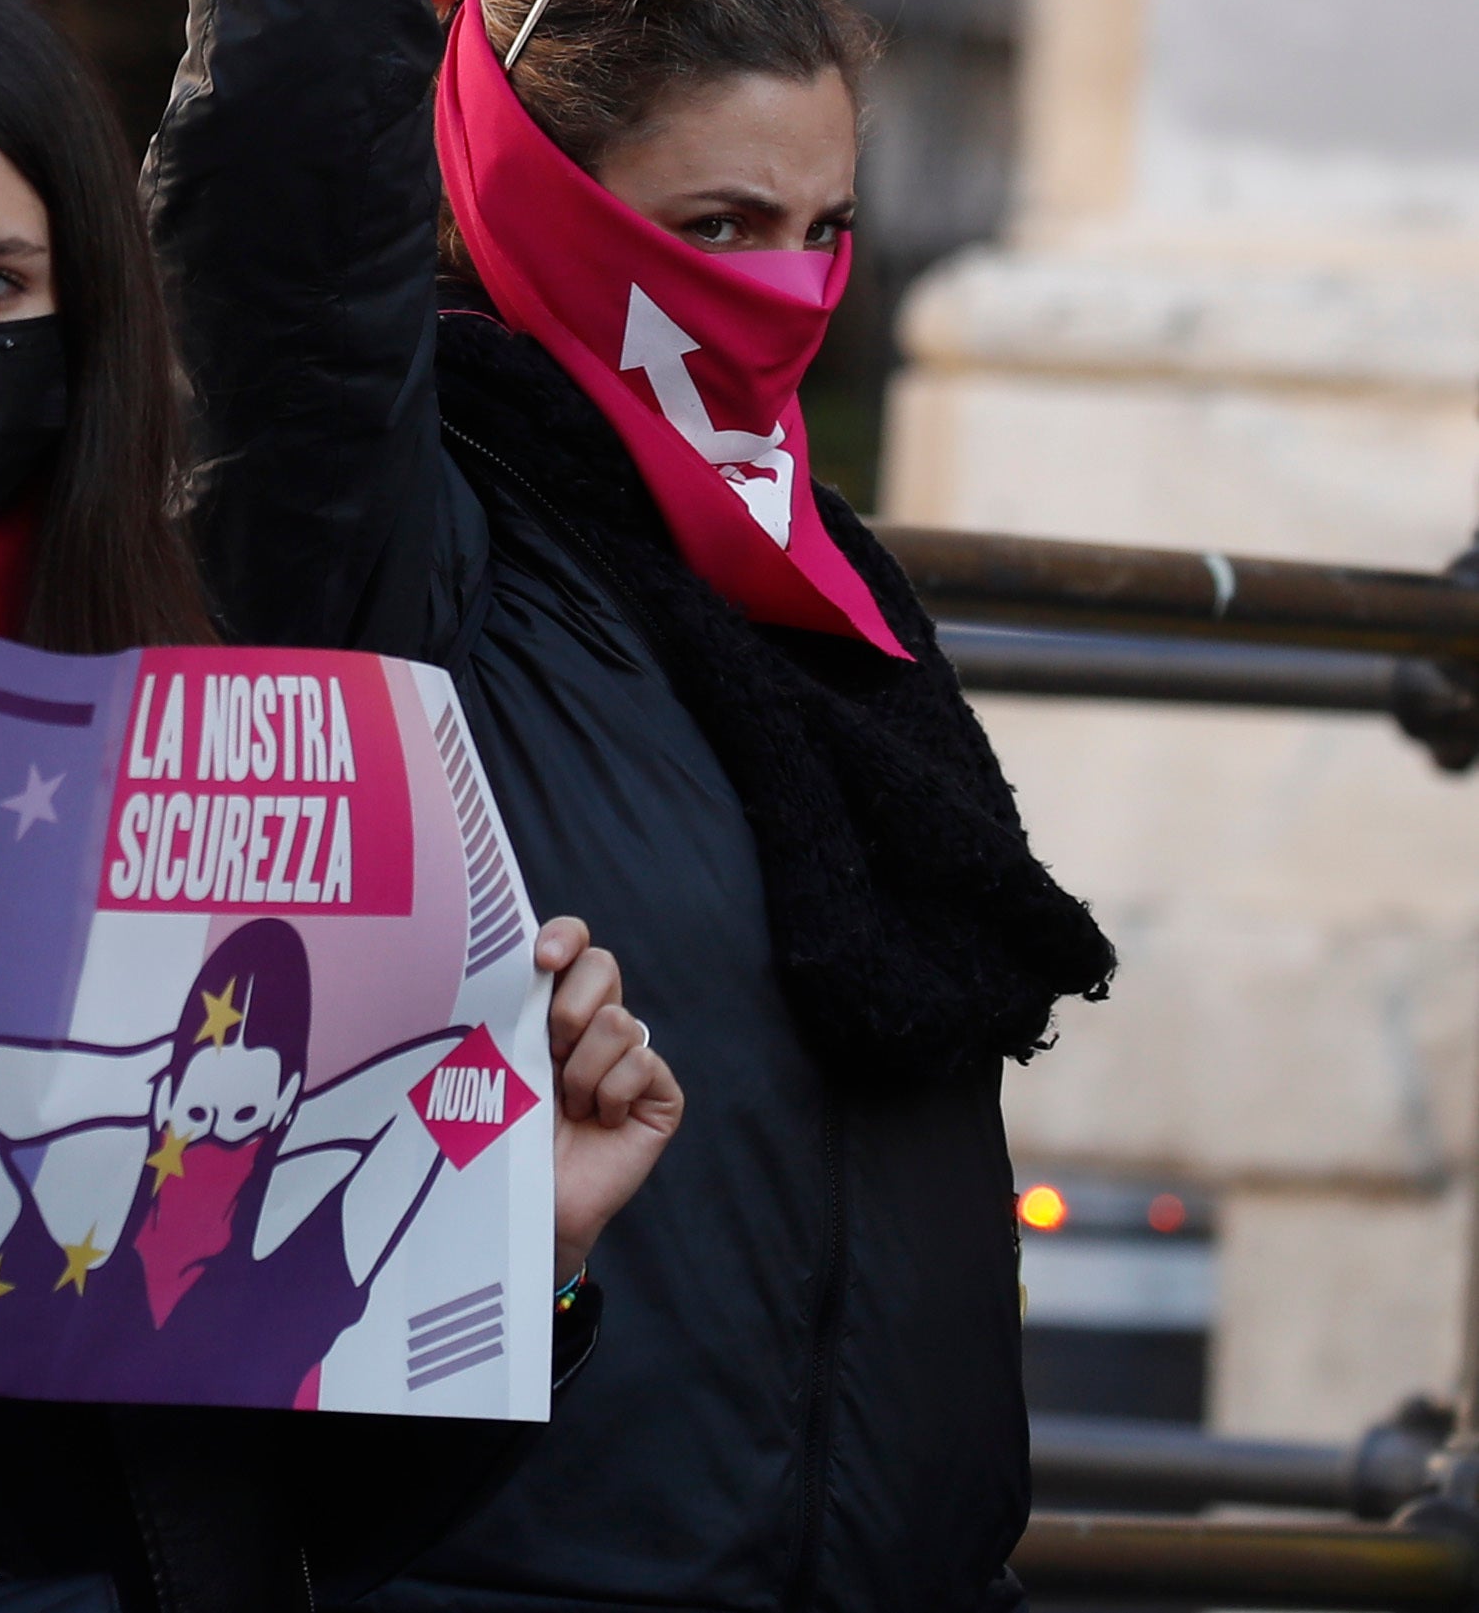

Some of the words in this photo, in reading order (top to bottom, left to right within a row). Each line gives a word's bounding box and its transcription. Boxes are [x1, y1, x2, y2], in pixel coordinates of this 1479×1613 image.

[128, 673, 185, 780] LA
[197, 673, 357, 783] NOSTRA
[109, 791, 353, 904] SICUREZZA
[426, 1066, 506, 1125] NUDM
